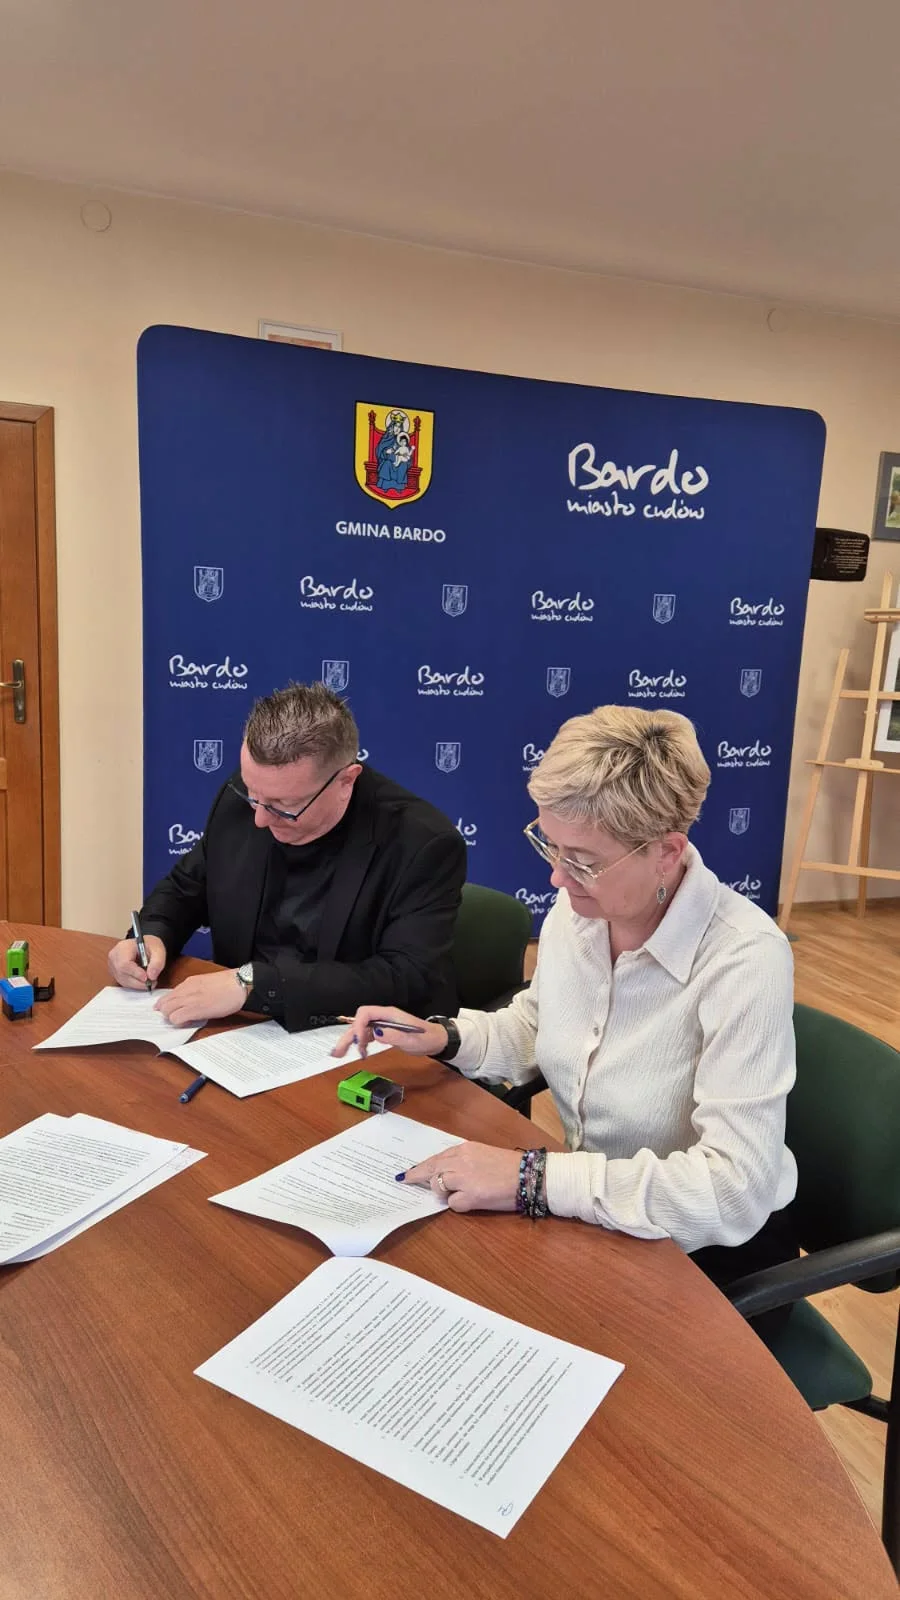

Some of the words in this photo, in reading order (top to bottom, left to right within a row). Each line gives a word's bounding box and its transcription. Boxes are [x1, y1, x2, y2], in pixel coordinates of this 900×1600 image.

[567, 442, 709, 495] Bardo
[567, 491, 636, 517] miasto
[643, 498, 705, 520] cudów
[335, 520, 391, 539] GMINA
[393, 525, 447, 543] BARDO
[299, 575, 374, 601] Bardo
[300, 598, 337, 611] miasto
[531, 590, 595, 612] Bardo
[729, 597, 785, 617] Bardo
[531, 610, 562, 622] miasto
[729, 615, 758, 627] miasto
[169, 654, 249, 678] Bardo
[417, 664, 485, 686] Bardo
[169, 676, 209, 689] miasto
[628, 668, 687, 688] Bardo
[417, 684, 451, 696] miasto
[628, 686, 657, 698] miasto
[717, 739, 772, 759] Bardo
[729, 874, 761, 892] rdo
